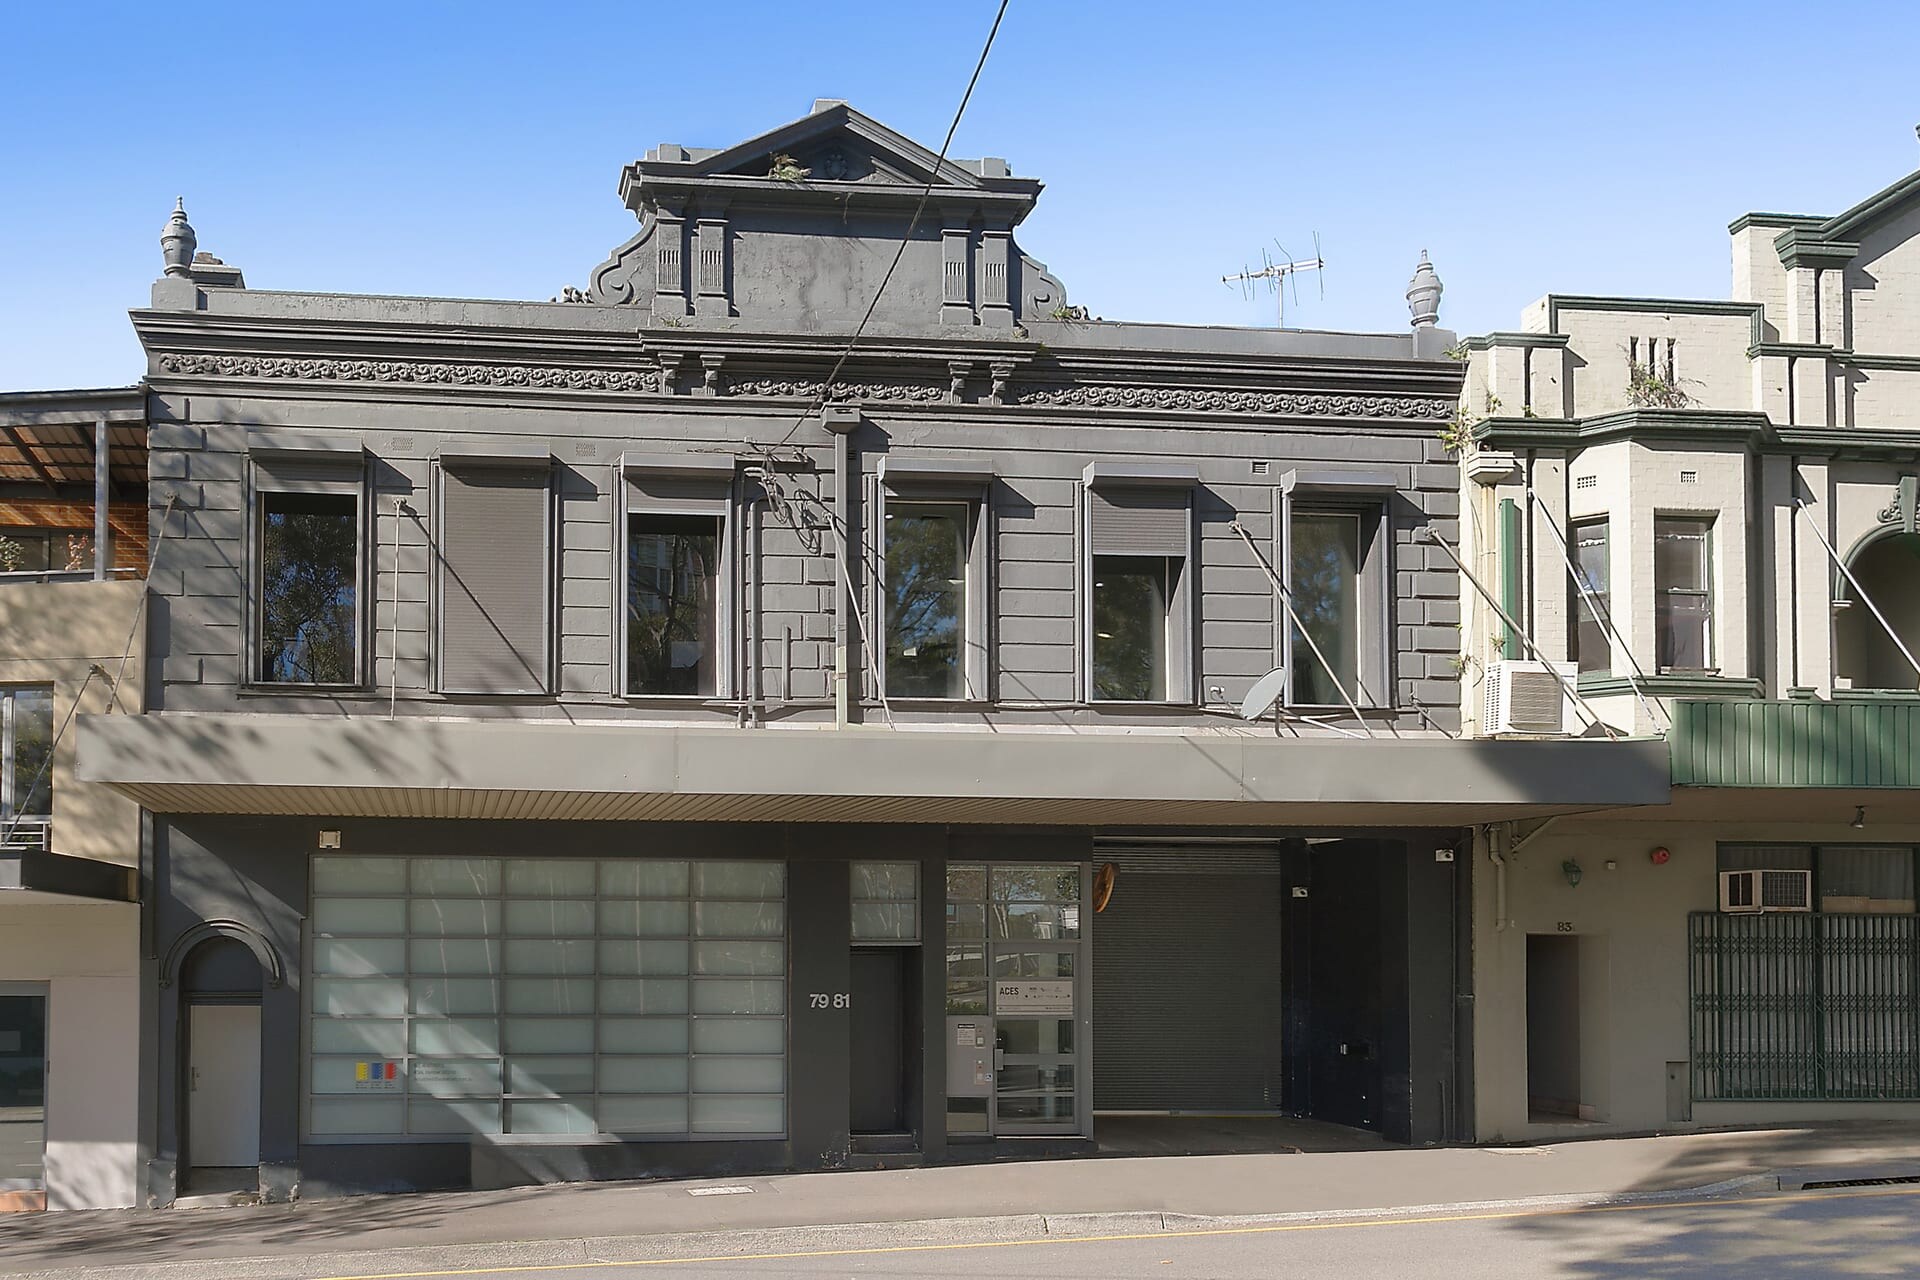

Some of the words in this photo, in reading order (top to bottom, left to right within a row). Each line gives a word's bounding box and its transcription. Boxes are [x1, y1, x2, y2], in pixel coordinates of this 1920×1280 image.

[1558, 921, 1572, 932] 83
[1000, 987, 1019, 996] ACES
[810, 993, 830, 1009] 79
[833, 993, 850, 1009] 81
